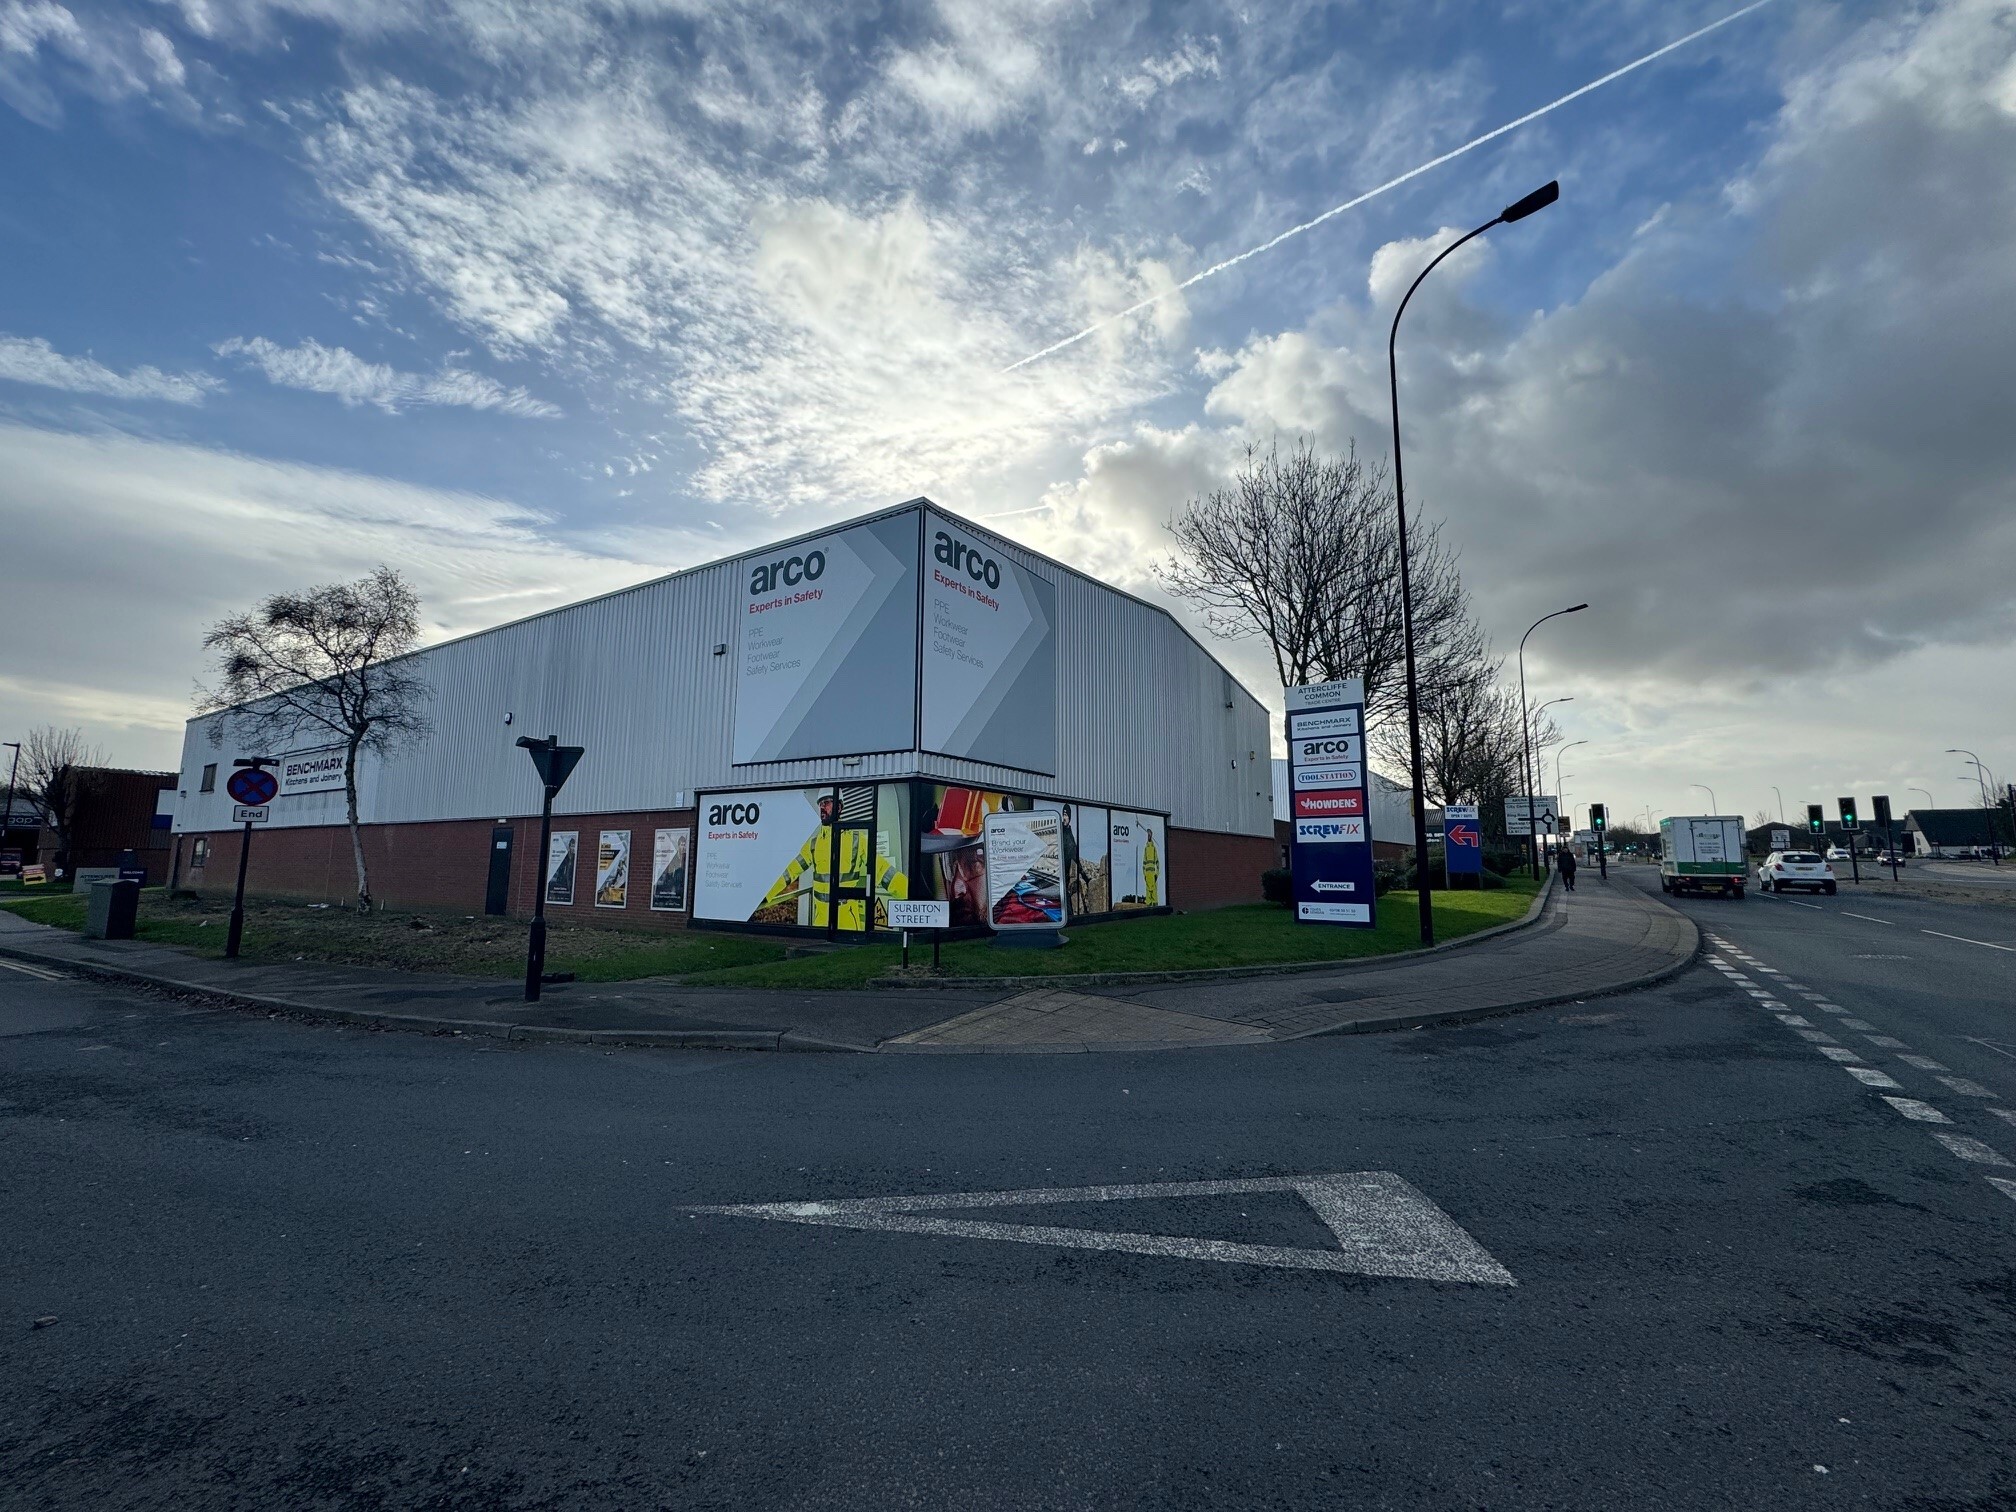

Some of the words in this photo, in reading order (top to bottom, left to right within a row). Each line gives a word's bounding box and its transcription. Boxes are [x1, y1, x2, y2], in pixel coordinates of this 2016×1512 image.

[934, 531, 1000, 590] arco
[750, 550, 826, 596] arco
[934, 569, 967, 594] Experts
[968, 586, 975, 598] in
[976, 590, 999, 612] Safety
[749, 598, 783, 614] Experts
[784, 595, 792, 606] in
[793, 588, 824, 605] Safety
[934, 599, 950, 615] PPE
[934, 613, 968, 635] Workwear
[748, 627, 764, 639] PPE
[934, 626, 966, 648] Footwear
[748, 637, 784, 651] Workwear
[747, 649, 780, 663] Footwear
[934, 641, 956, 660] Safety
[957, 649, 984, 669] Services
[746, 664, 769, 677] Safety
[769, 659, 801, 672] Services
[1298, 682, 1348, 695] ATTERCLIFFE
[1304, 690, 1341, 701] COMMON
[1297, 716, 1351, 728] BENCHMARX
[1303, 740, 1349, 756] arco
[286, 757, 343, 776] BENCHMARX
[285, 777, 308, 786] Kitchens
[320, 773, 342, 783] Joinery
[1301, 771, 1354, 781] TOOLSTATION
[1309, 798, 1358, 809] HOWDENS
[240, 810, 263, 818] End
[708, 803, 760, 826] arco
[708, 831, 731, 840] Experts
[732, 831, 738, 839] in
[738, 831, 758, 840] Safety
[1113, 825, 1130, 837] arco
[1299, 823, 1360, 839] SCREWFIX
[1012, 839, 1027, 847] your
[894, 904, 941, 913] SURBITON
[895, 915, 930, 924] STREET
